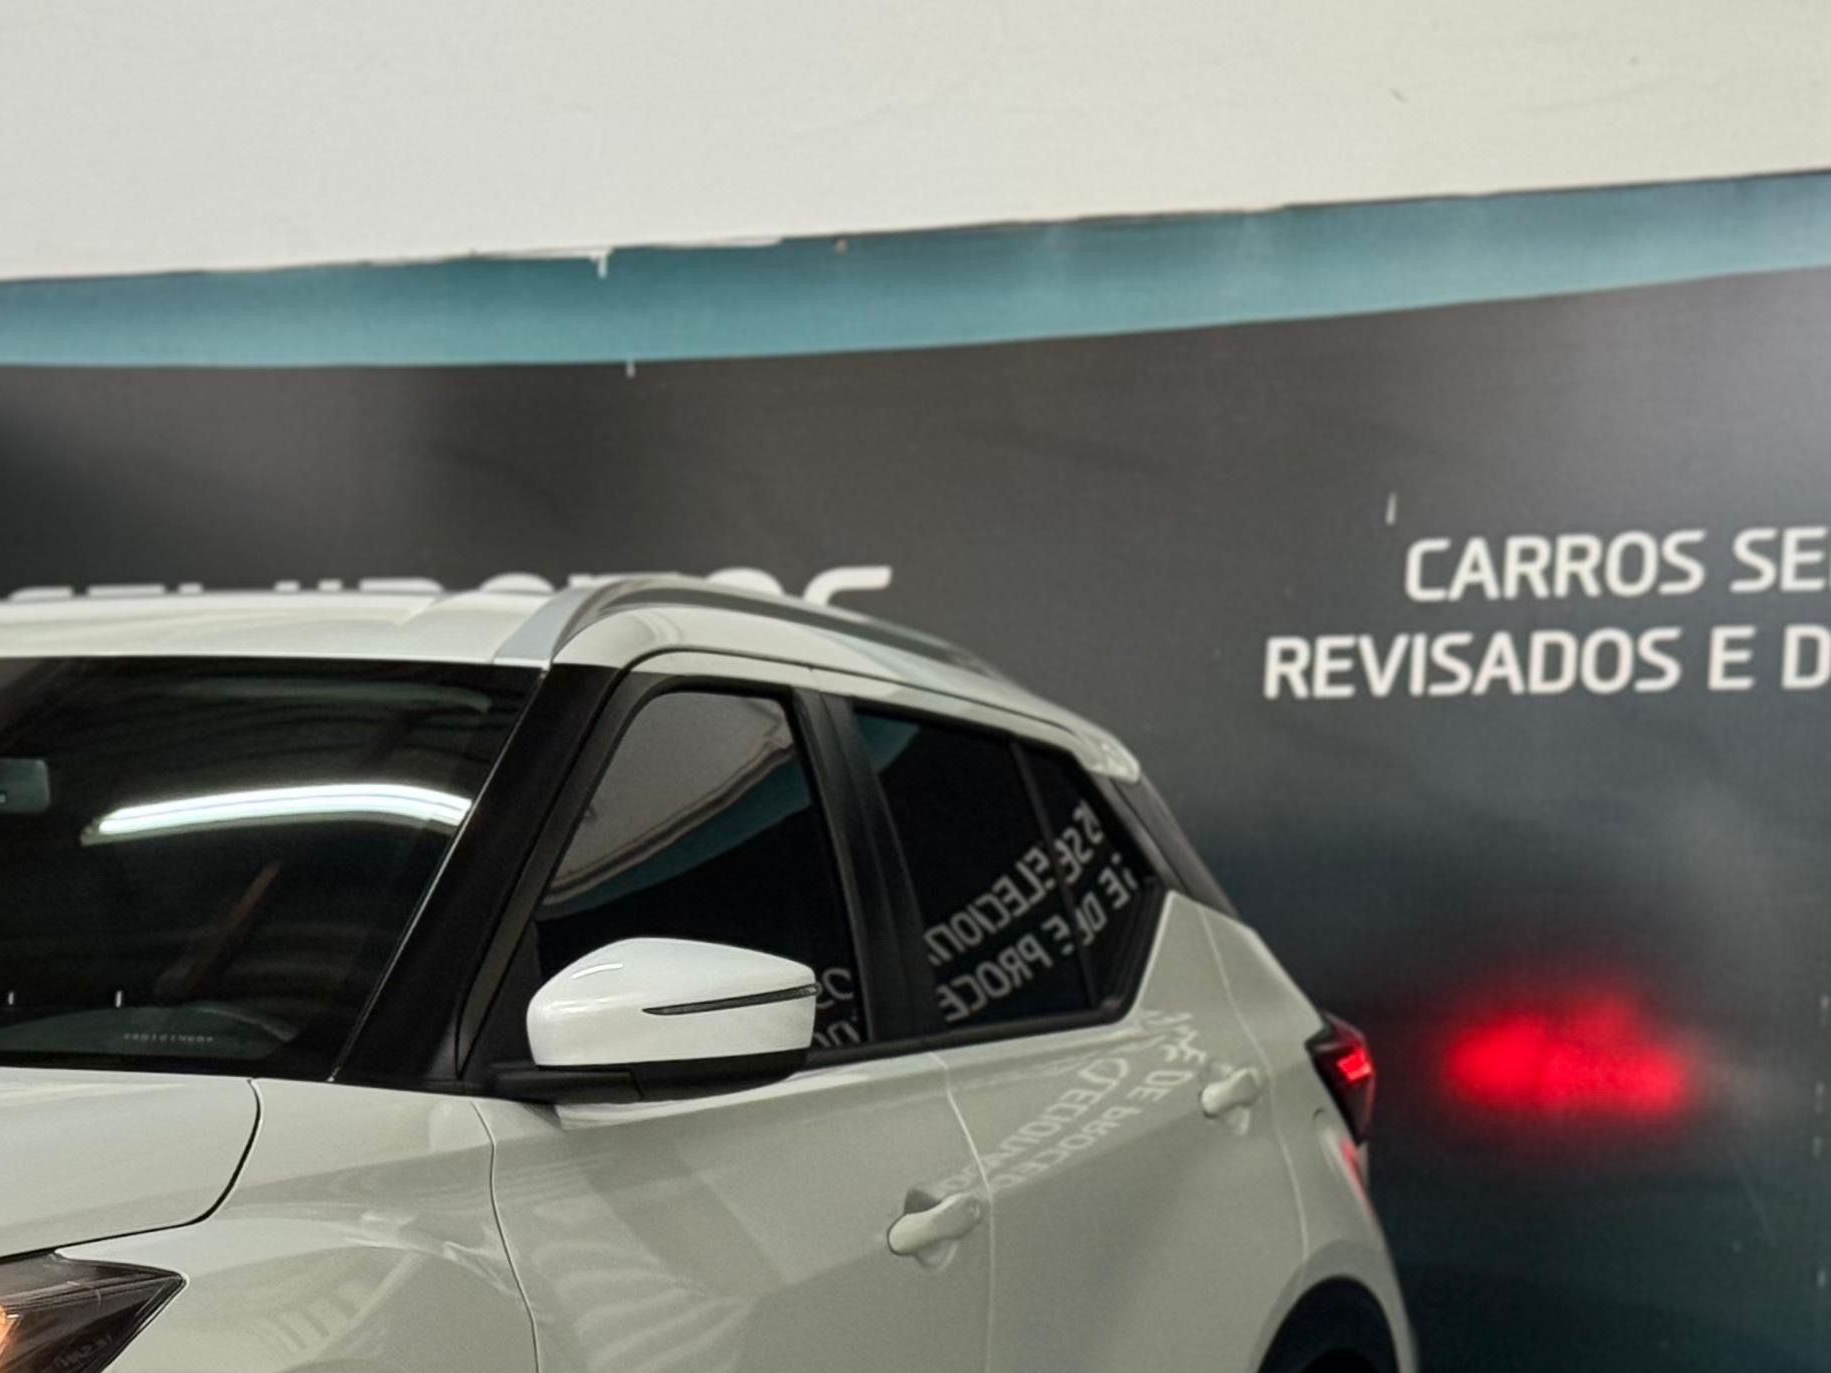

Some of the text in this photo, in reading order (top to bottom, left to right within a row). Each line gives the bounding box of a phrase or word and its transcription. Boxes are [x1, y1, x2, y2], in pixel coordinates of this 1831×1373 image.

[1404, 526, 1831, 602] CARROS SE
[1263, 626, 1683, 700] REVISADOS
[1708, 625, 1757, 691] E
